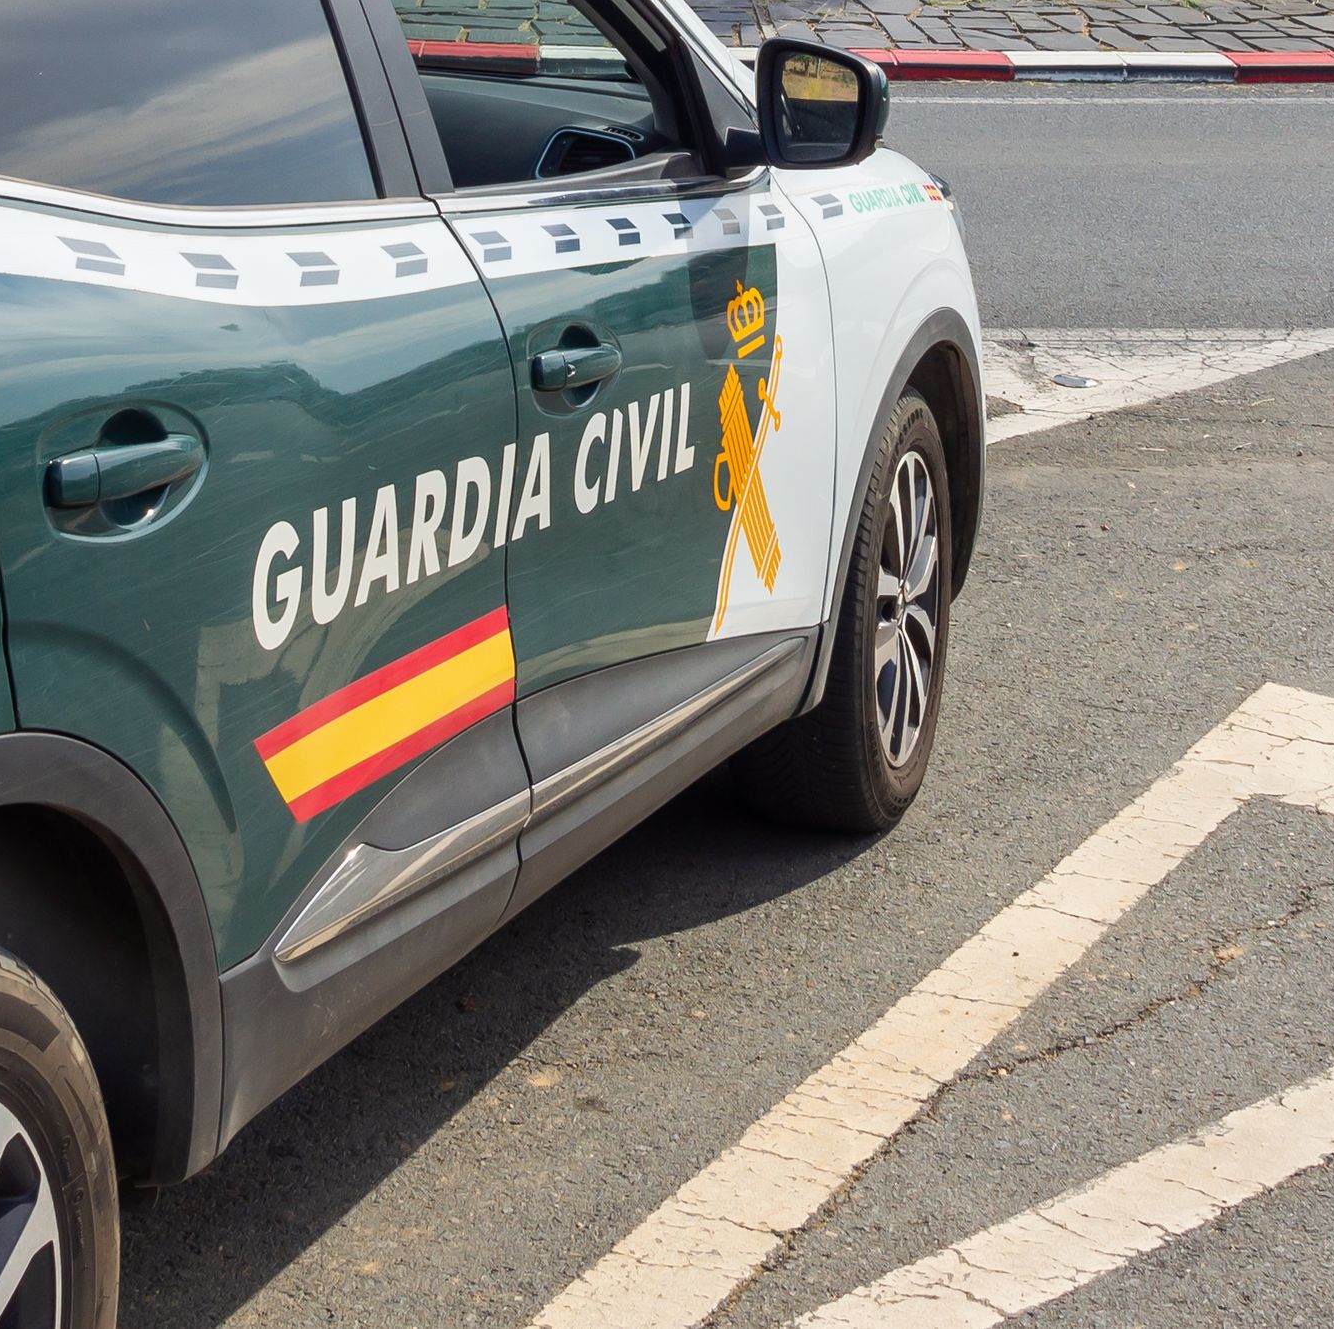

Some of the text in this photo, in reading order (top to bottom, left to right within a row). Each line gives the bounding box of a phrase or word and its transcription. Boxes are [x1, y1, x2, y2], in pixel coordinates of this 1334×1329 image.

[848, 183, 925, 213] GUARDIA CIVIL
[252, 431, 551, 651] GUARDIA
[574, 382, 695, 514] CIVIL
